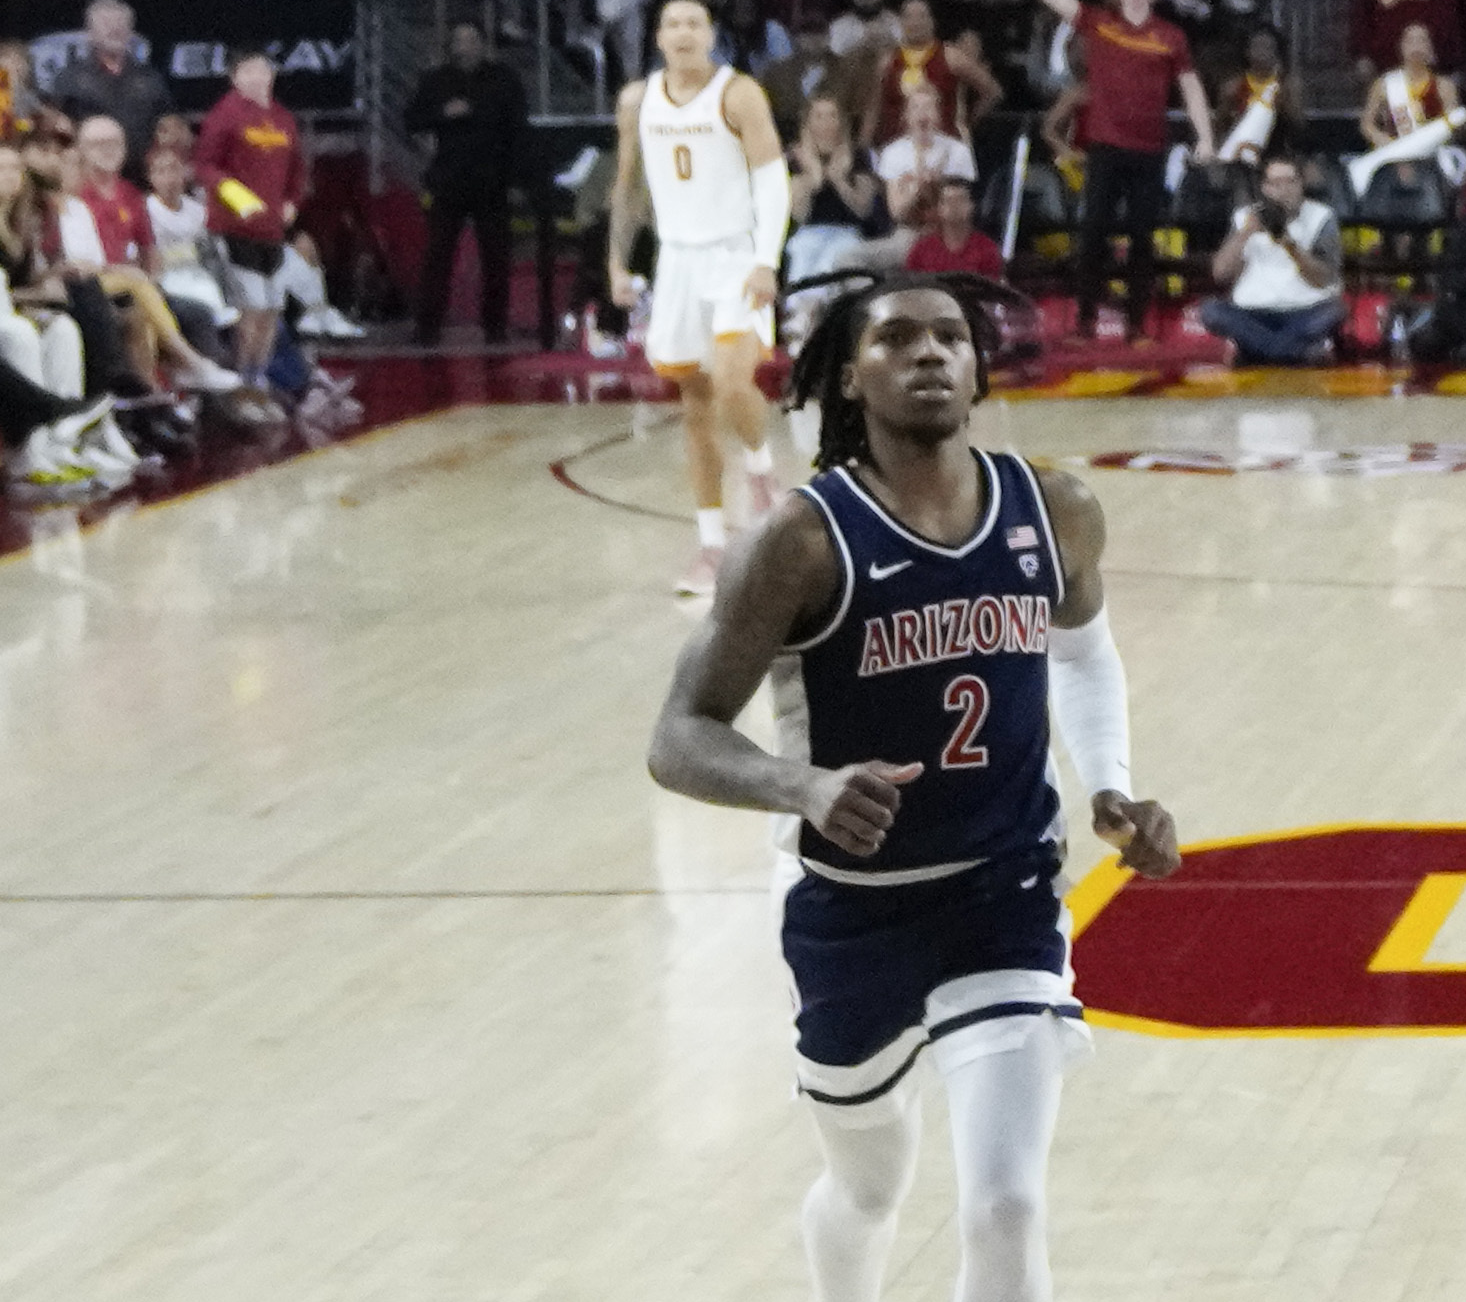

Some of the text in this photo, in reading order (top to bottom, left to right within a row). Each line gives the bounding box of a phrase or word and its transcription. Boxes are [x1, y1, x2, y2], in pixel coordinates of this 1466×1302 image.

[672, 143, 693, 182] 0
[858, 594, 1052, 677] ARIZONA
[940, 673, 990, 770] 2
